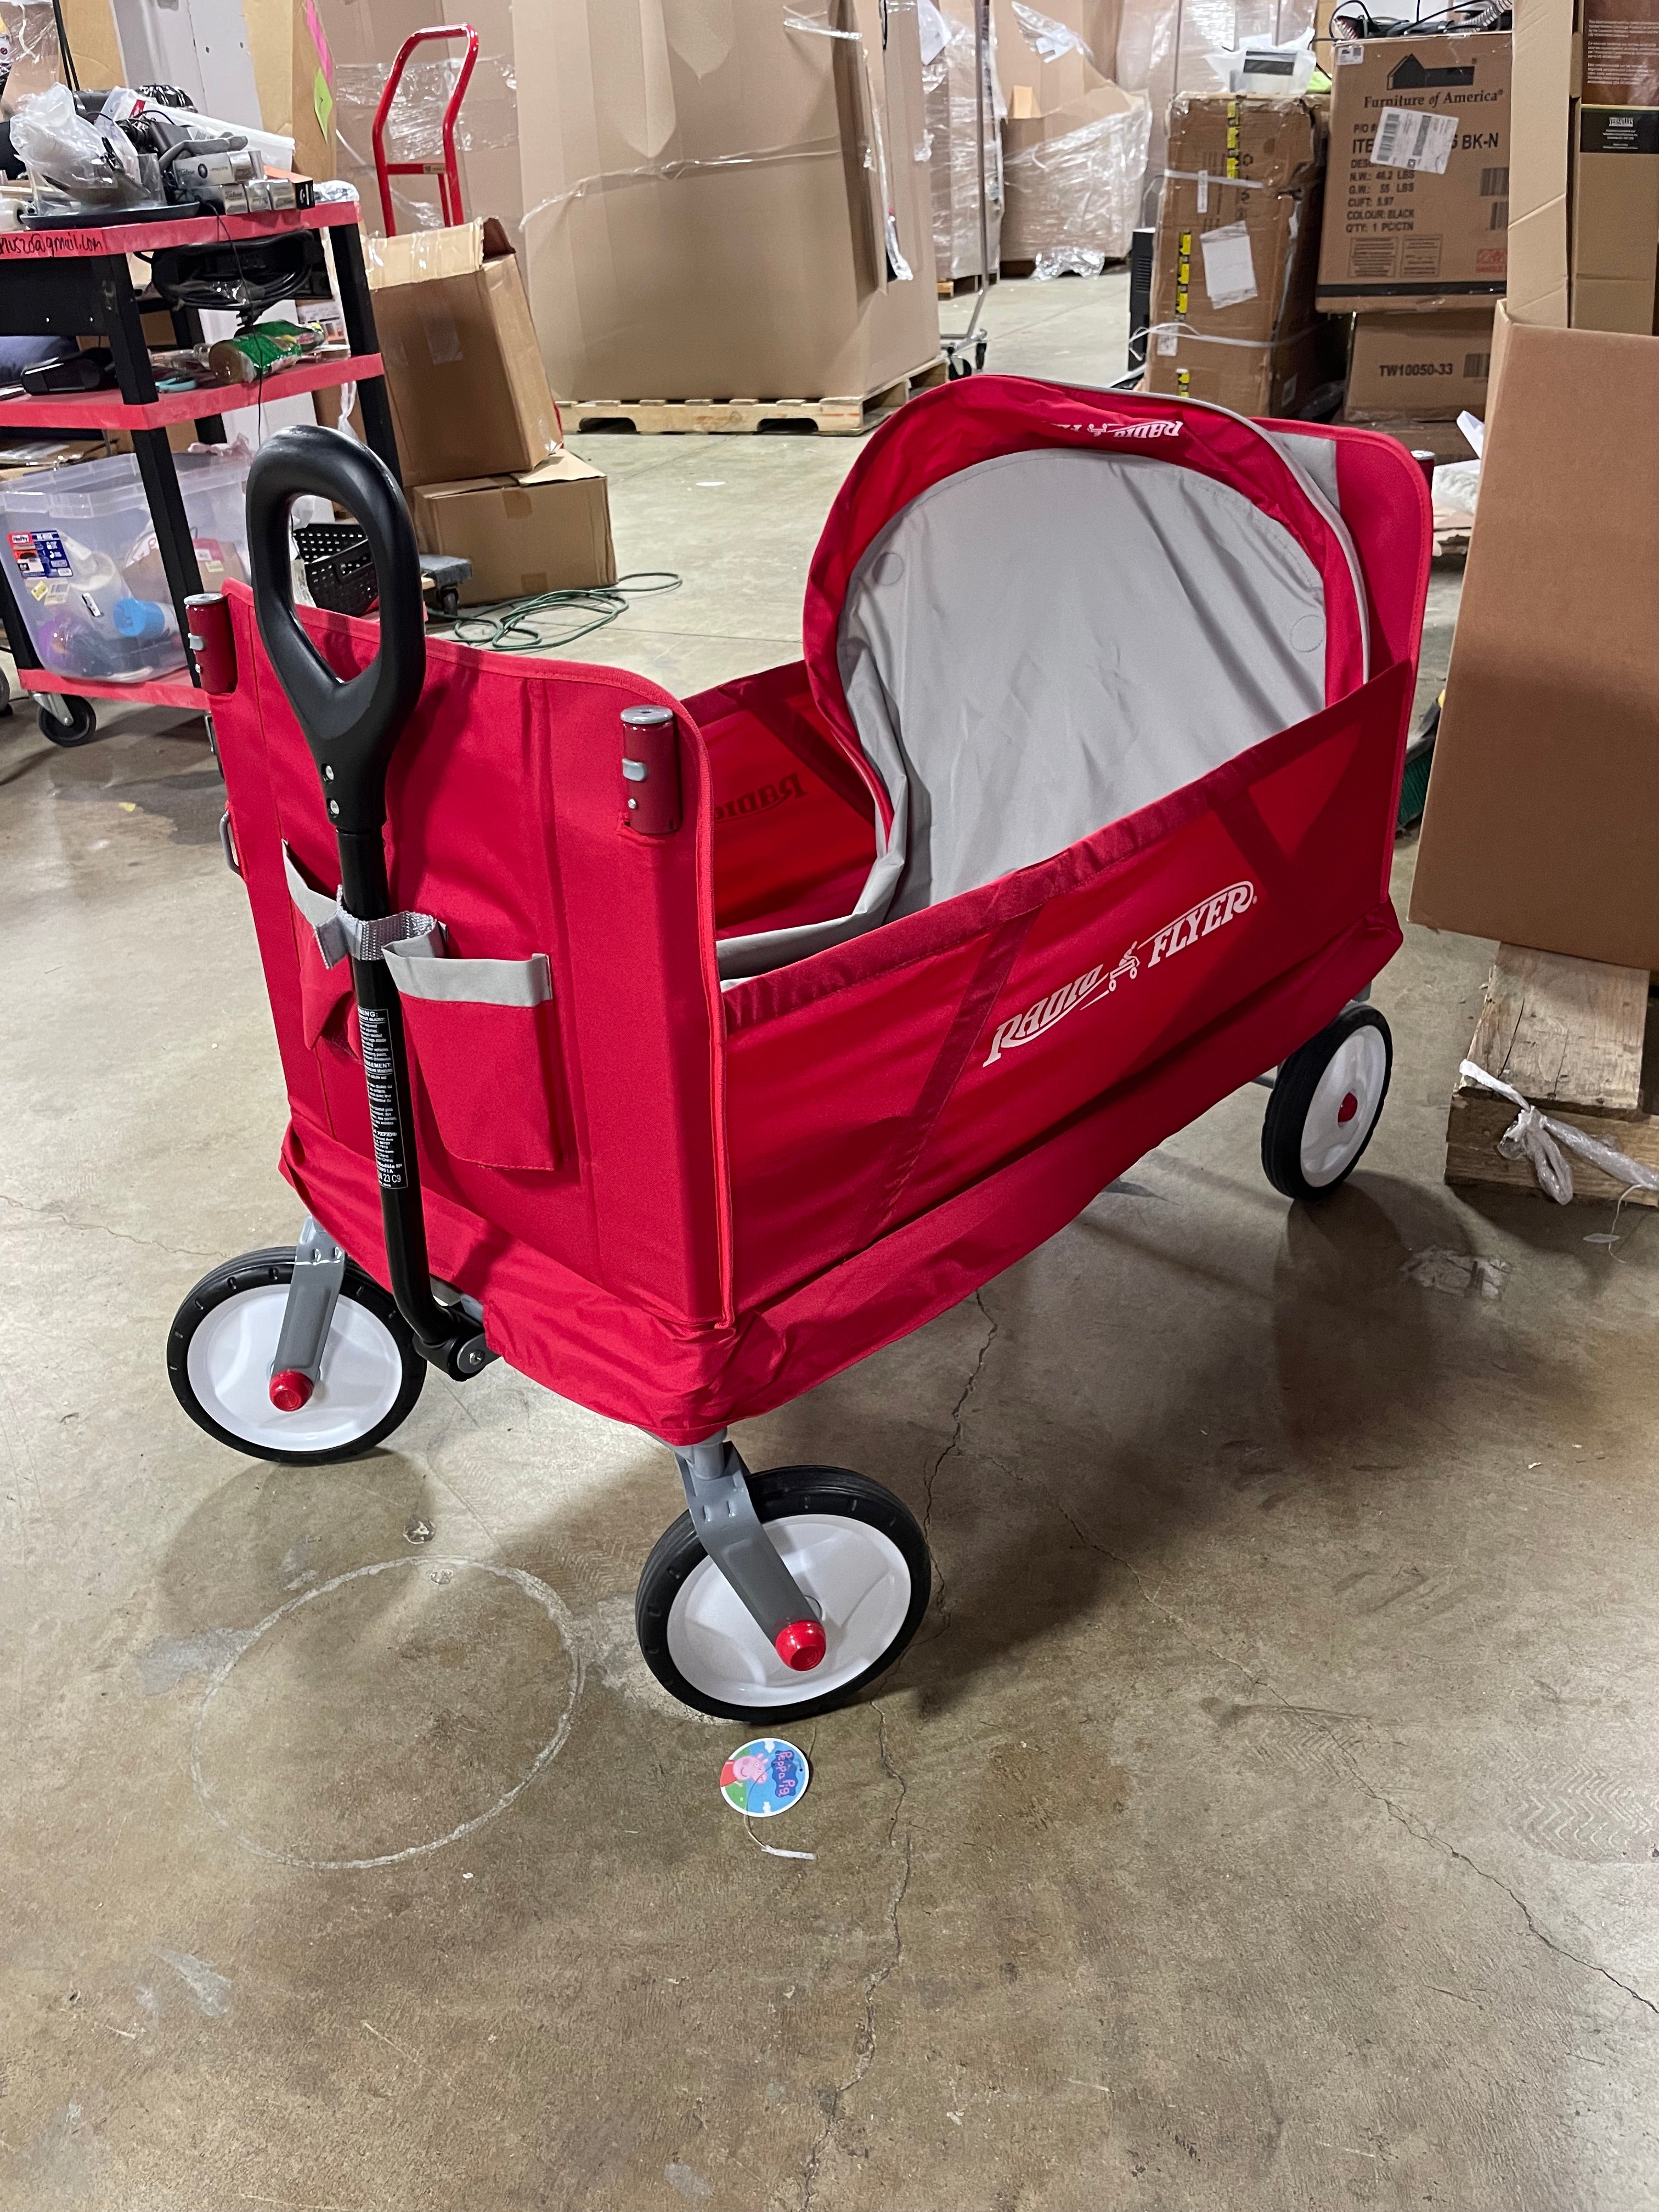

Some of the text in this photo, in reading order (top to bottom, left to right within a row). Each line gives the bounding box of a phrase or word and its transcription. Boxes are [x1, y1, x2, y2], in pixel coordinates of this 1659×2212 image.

[1364, 94, 1424, 108] Furniture
[1429, 92, 1441, 108] of
[1352, 138, 1374, 153] ITE
[1397, 170, 1414, 180] LBS
[1396, 183, 1414, 193] LBS
[1387, 209, 1414, 219] BLACK
[1379, 363, 1453, 377] TW10050-33
[983, 881, 1254, 1068] RADIO FLYER
[391, 1174, 402, 1183] C9
[774, 1751, 793, 1780] Peppa
[778, 1779, 795, 1795] Pig
